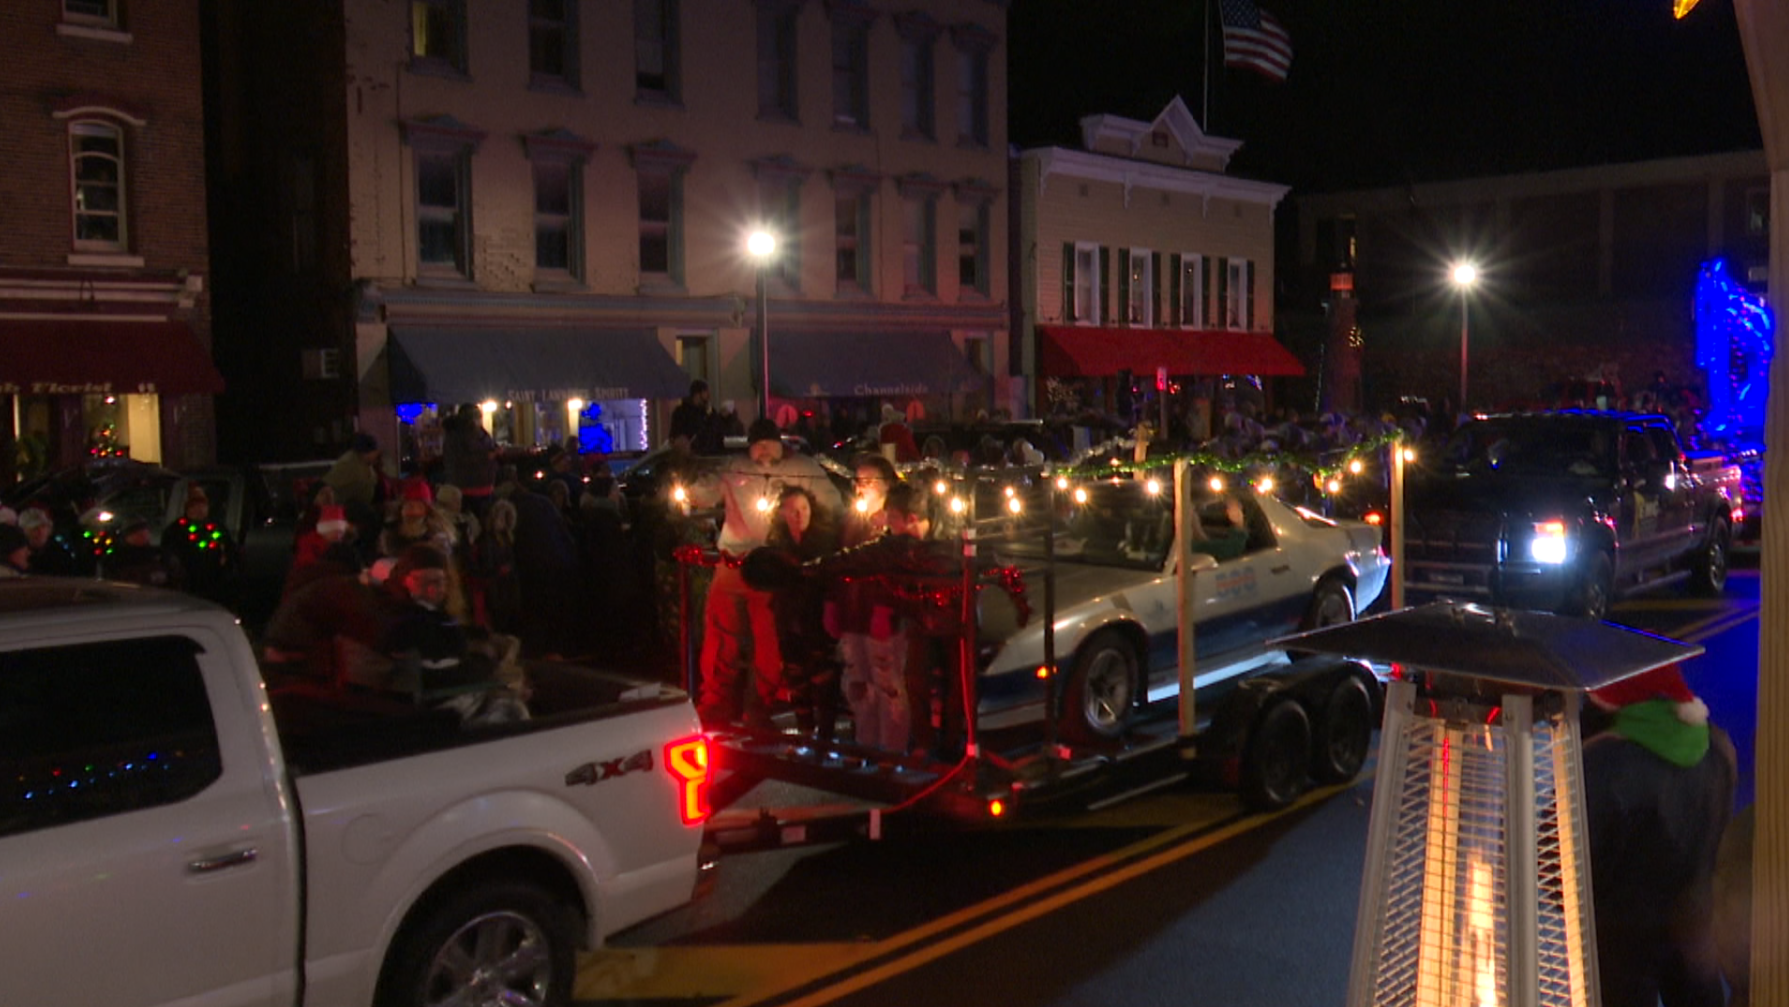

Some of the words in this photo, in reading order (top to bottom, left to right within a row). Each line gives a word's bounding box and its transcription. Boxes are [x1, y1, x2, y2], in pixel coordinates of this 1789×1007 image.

[30, 382, 112, 394] Florist
[854, 383, 930, 397] Channelside
[507, 389, 536, 403] SAINT
